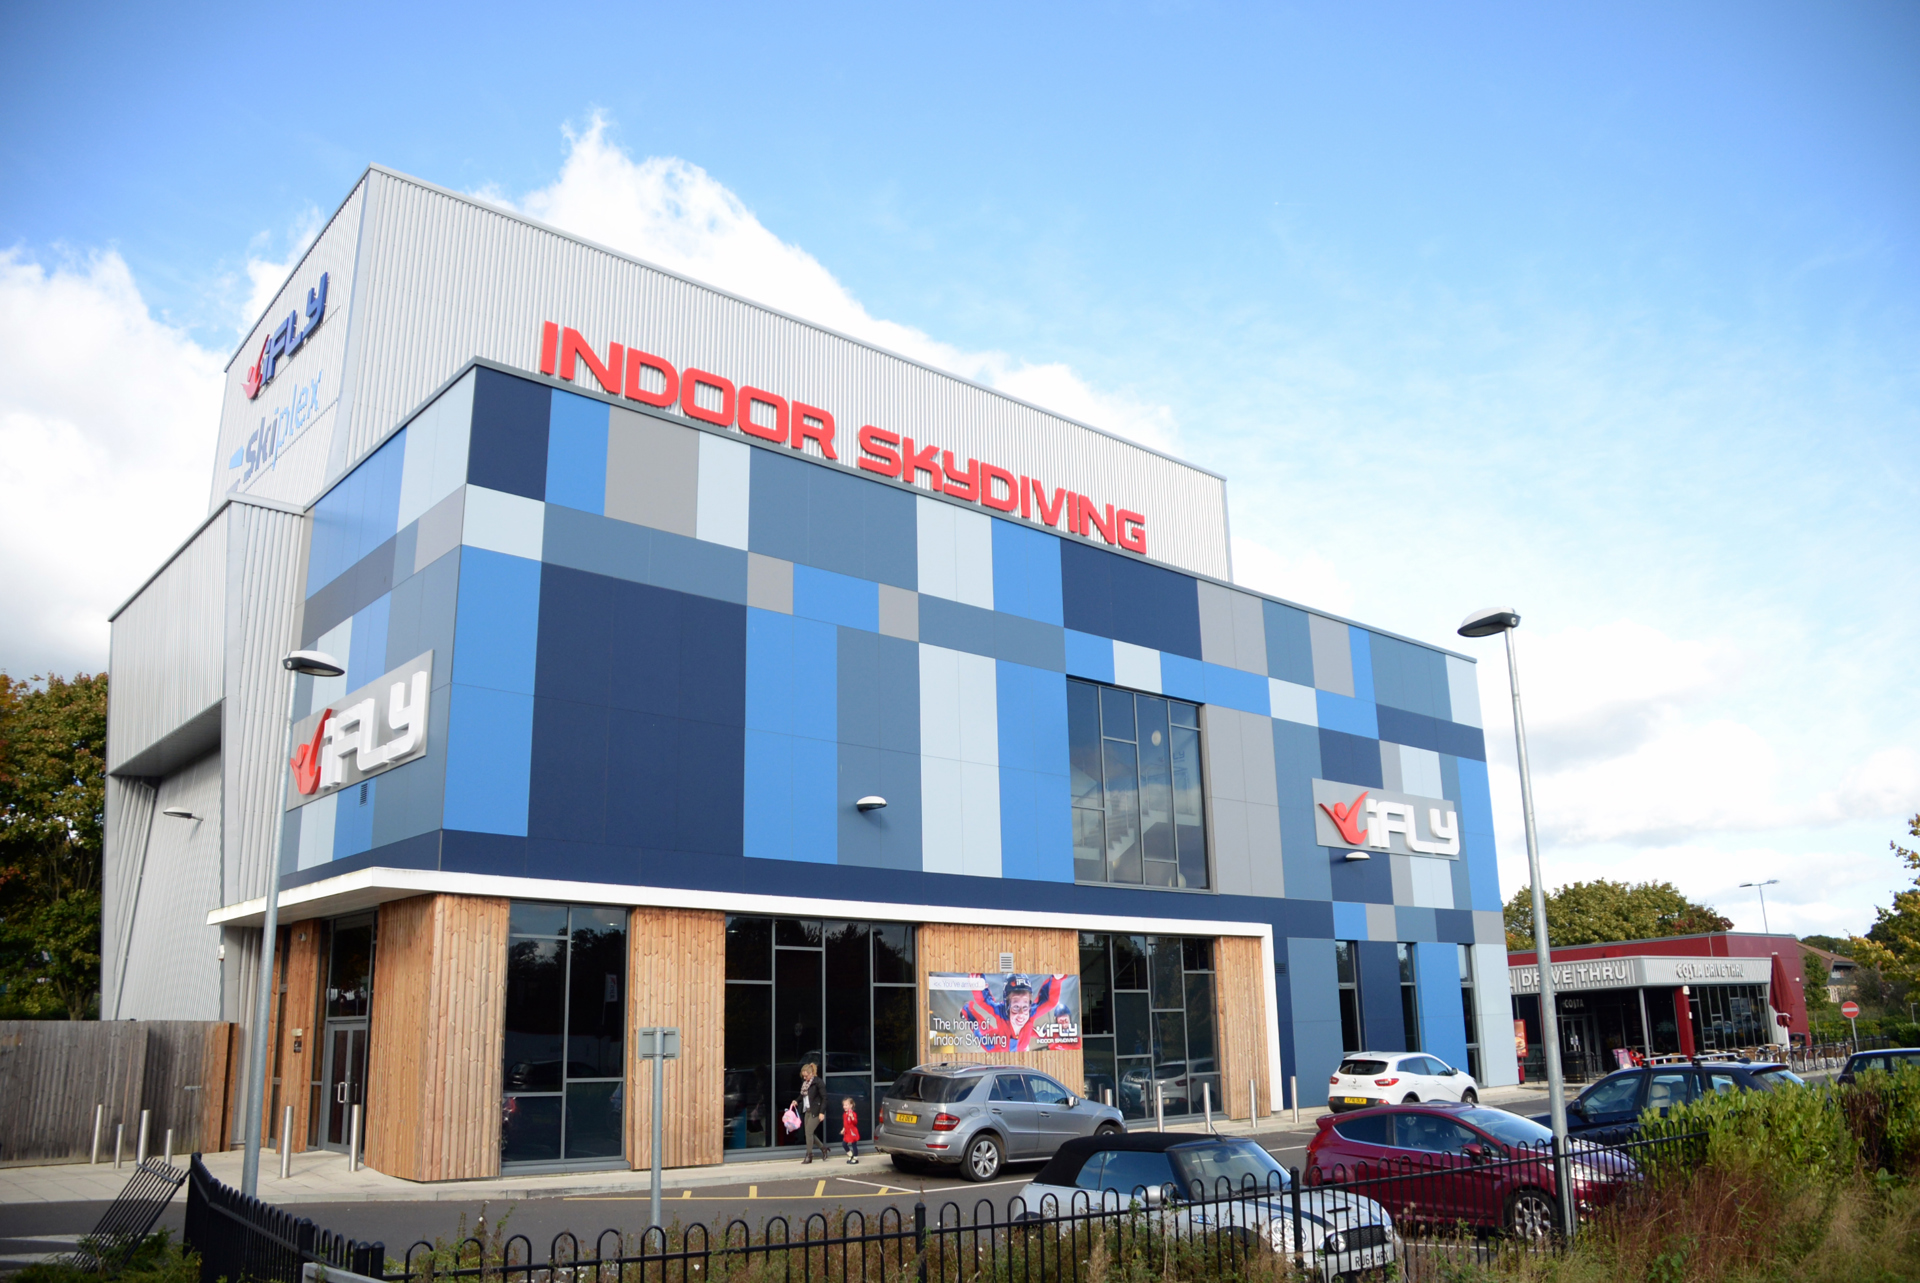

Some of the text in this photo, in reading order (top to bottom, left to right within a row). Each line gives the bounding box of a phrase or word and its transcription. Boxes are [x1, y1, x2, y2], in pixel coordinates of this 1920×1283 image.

[242, 368, 324, 485] skiplex
[539, 320, 1148, 555] INDOOR SKYDIVING
[1521, 969, 1573, 987] DRVE
[1577, 965, 1626, 982] THRU
[1676, 963, 1745, 979] COSTA DRIVE THRU
[933, 1017, 990, 1030] The home of
[933, 1033, 1007, 1048] Indoor Skydiving
